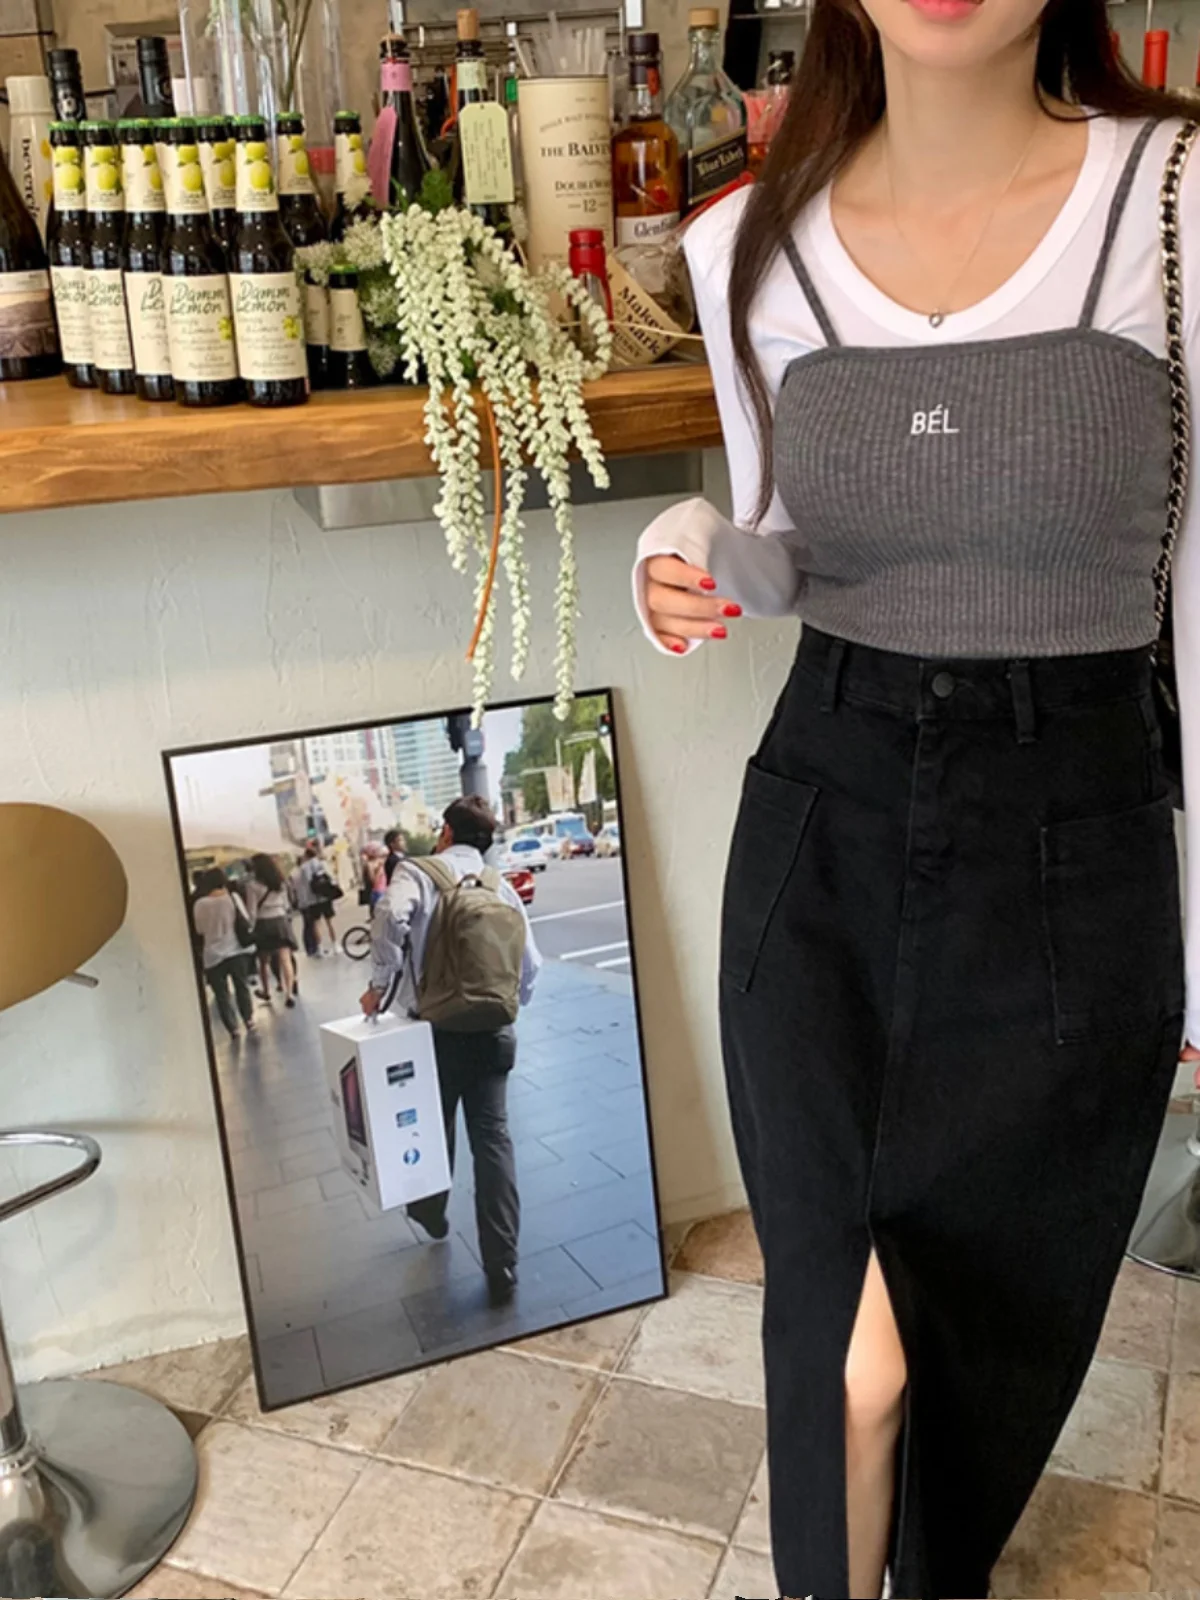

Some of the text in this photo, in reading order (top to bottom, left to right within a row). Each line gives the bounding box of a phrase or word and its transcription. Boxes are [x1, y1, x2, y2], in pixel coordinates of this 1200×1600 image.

[541, 146, 563, 158] THE
[583, 198, 597, 213] 12
[239, 279, 291, 301] Damm
[169, 295, 222, 315] Lemon
[235, 293, 287, 313] Lemon
[910, 403, 961, 435] BÉL
